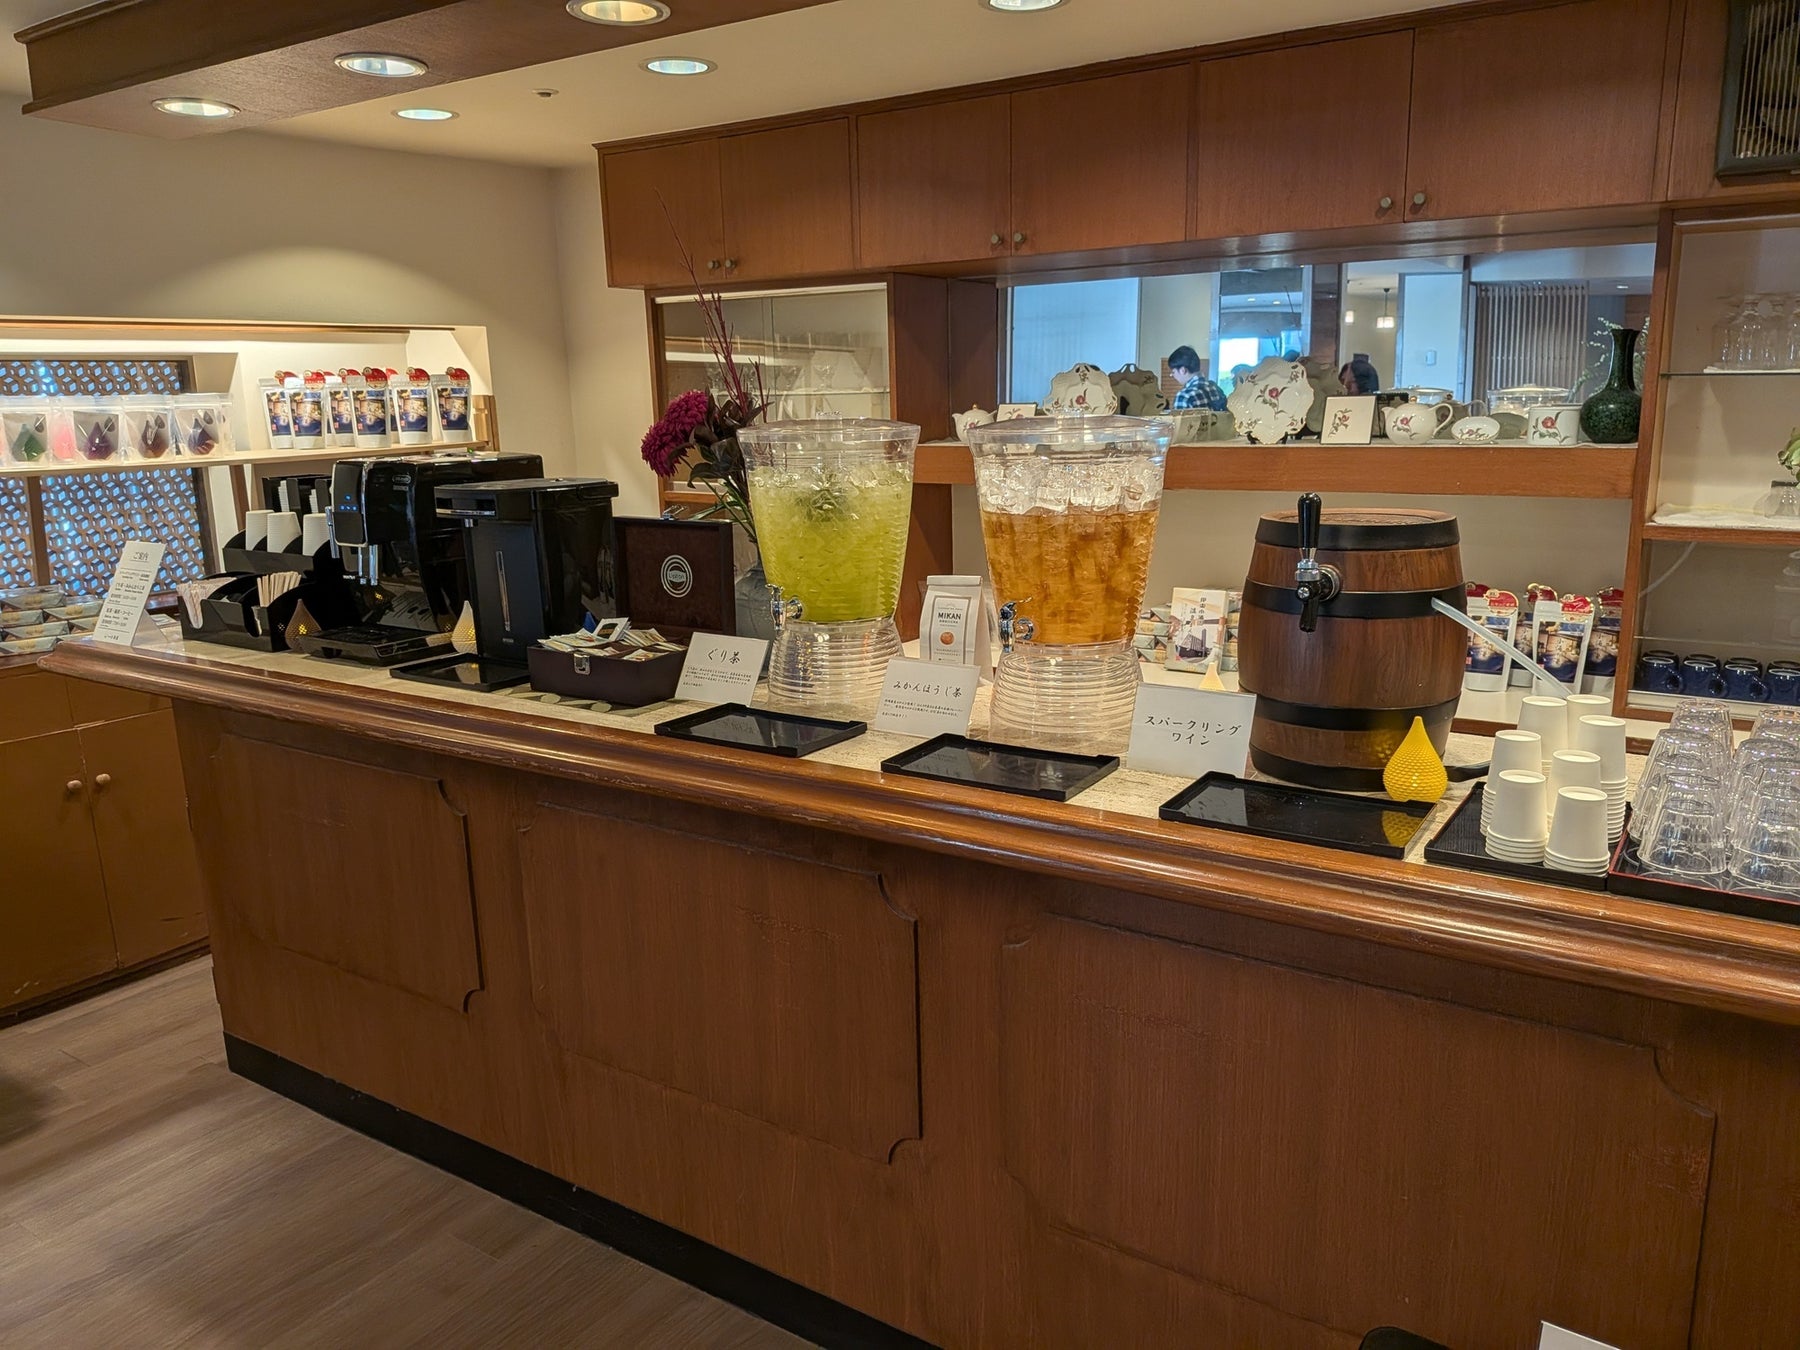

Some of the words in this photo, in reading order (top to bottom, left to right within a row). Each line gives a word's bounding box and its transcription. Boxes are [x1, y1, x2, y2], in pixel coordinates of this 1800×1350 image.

[938, 612, 961, 620] MIKAN
[707, 648, 741, 665] ぐり茶
[893, 681, 962, 698] みかんほうじ茶
[1145, 716, 1242, 736] スパークリング
[1172, 732, 1210, 746] ワイン
